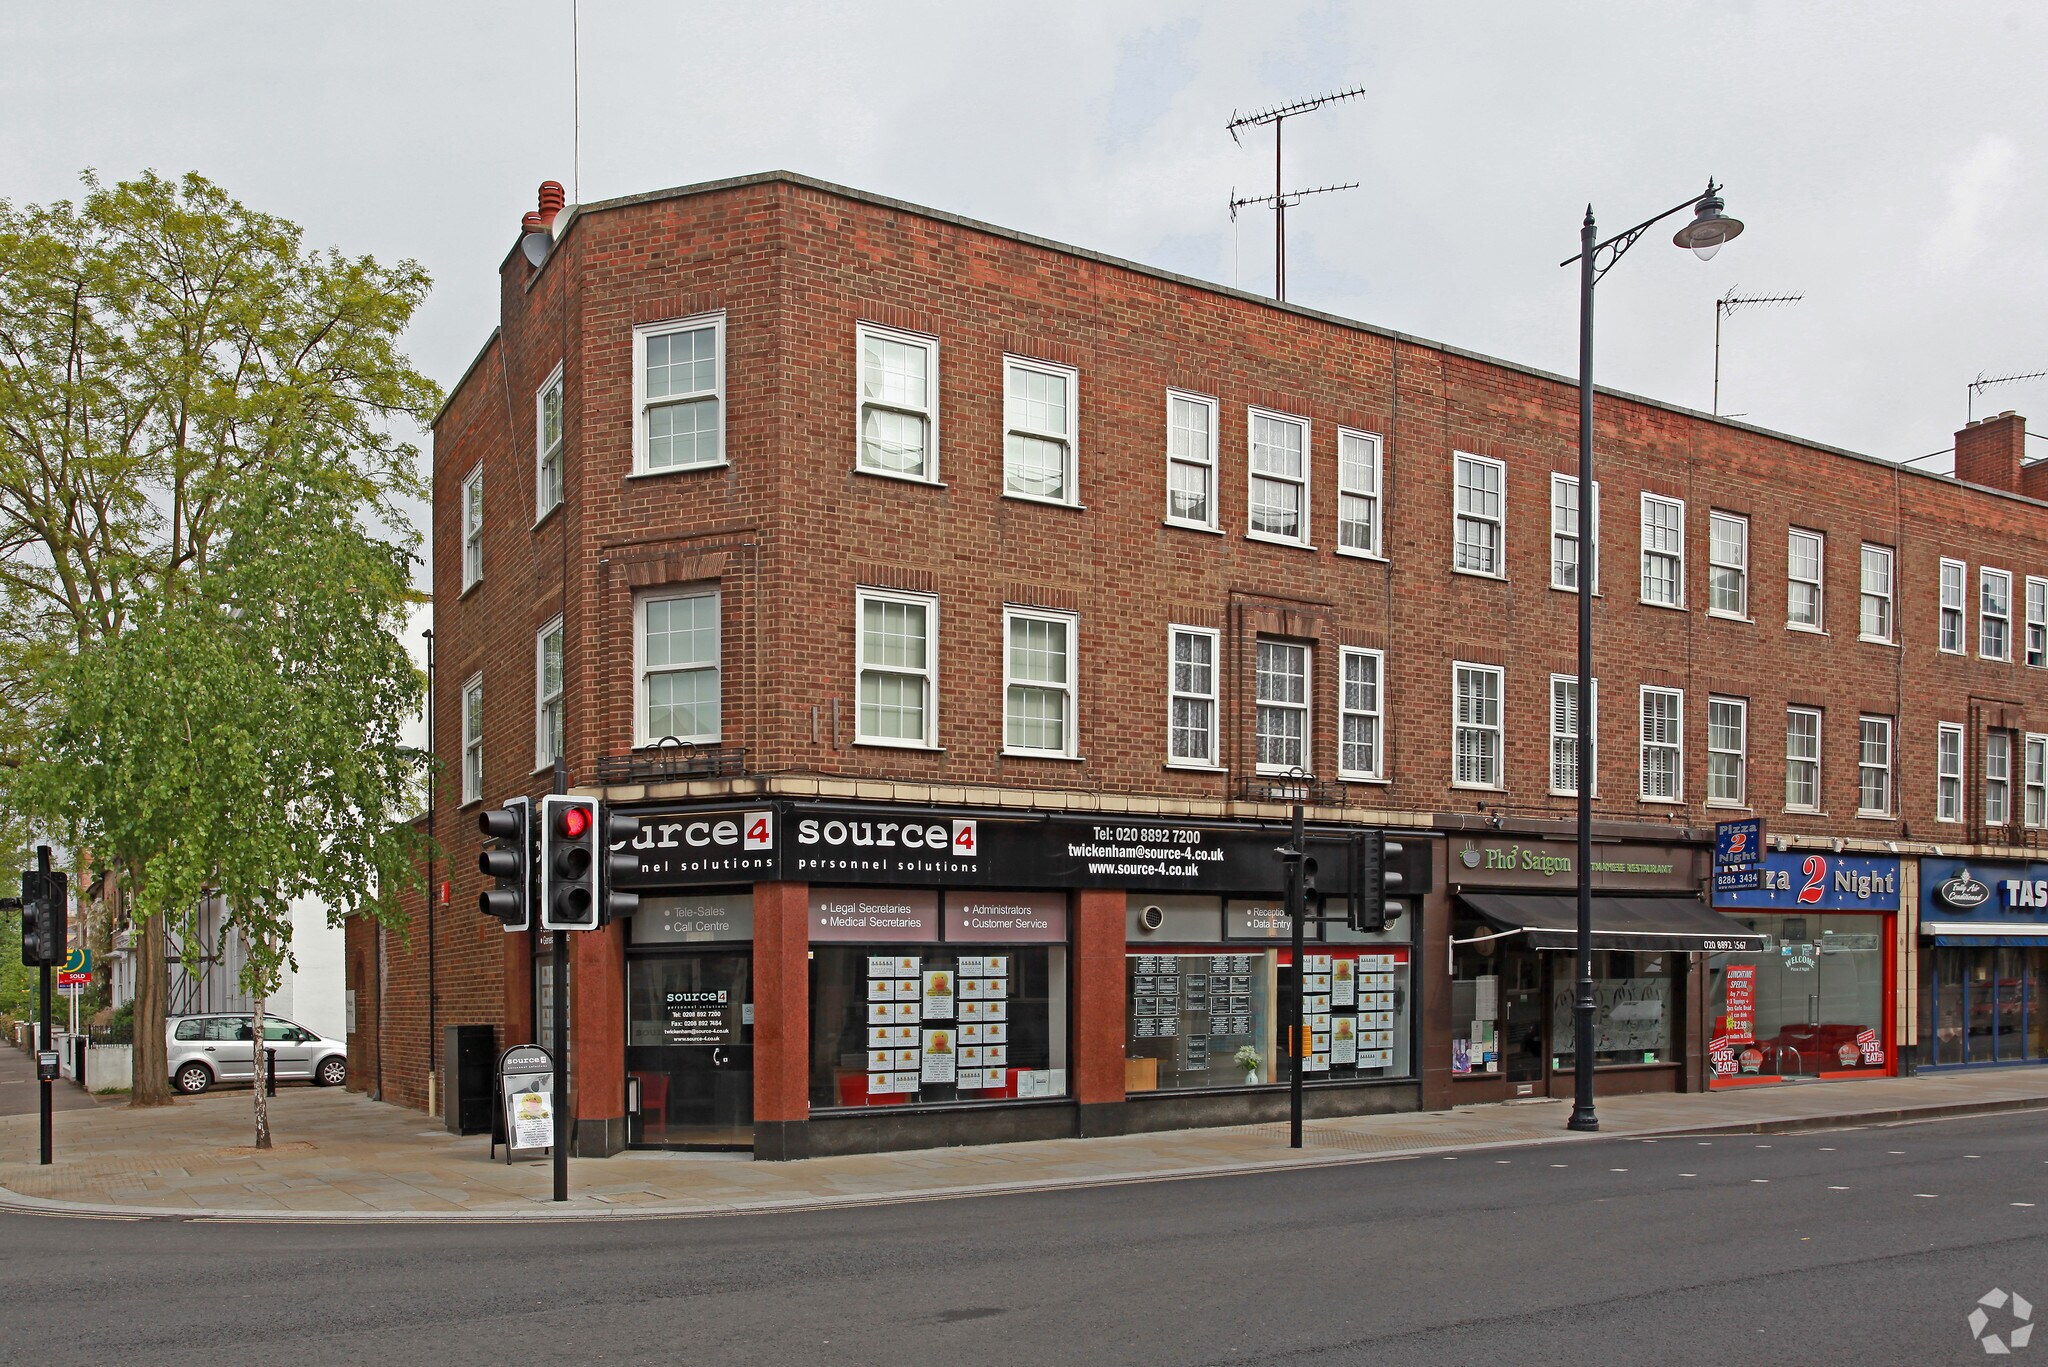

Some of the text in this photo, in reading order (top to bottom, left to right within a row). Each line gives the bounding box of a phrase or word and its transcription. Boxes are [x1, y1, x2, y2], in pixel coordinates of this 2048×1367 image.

[610, 813, 772, 851] urce4
[1093, 827, 1201, 844] Tel: 020 8892 7200
[1719, 824, 1758, 835] Pizza
[798, 819, 976, 856] source4
[1727, 833, 1747, 854] 2
[1068, 843, 1225, 862] twickenham@source-4.co.uk
[1719, 851, 1757, 863] Night
[641, 858, 773, 873] nel solutions
[798, 858, 977, 872] personnel solutions
[1088, 861, 1199, 876] www.source-4.co.uk
[1521, 850, 1572, 876] Saigon
[1590, 862, 1626, 872] TNAMESE
[1718, 873, 1758, 885] 8286 3434
[1797, 855, 1827, 904] 2
[1834, 870, 1894, 899] Night
[674, 907, 725, 918] Tele-Sales
[830, 903, 912, 914] Legal Secretaries
[972, 905, 1032, 915] Administrators
[1253, 908, 1285, 918] Receptio
[674, 921, 729, 932] Call Centre
[830, 916, 922, 928] Medical Secretaries
[972, 918, 1048, 929] Customer Service
[1253, 919, 1291, 931] Data Entry
[1703, 940, 1715, 949] 020
[1717, 940, 1733, 950] 8892
[1785, 956, 1815, 969] WELCOME
[1730, 981, 1748, 989] SPECIAL
[667, 990, 727, 1002] source4
[1862, 1042, 1879, 1052] JUST
[1713, 1050, 1733, 1061] JUST
[1866, 1052, 1878, 1062] EAT
[1717, 1061, 1732, 1072] EAT
